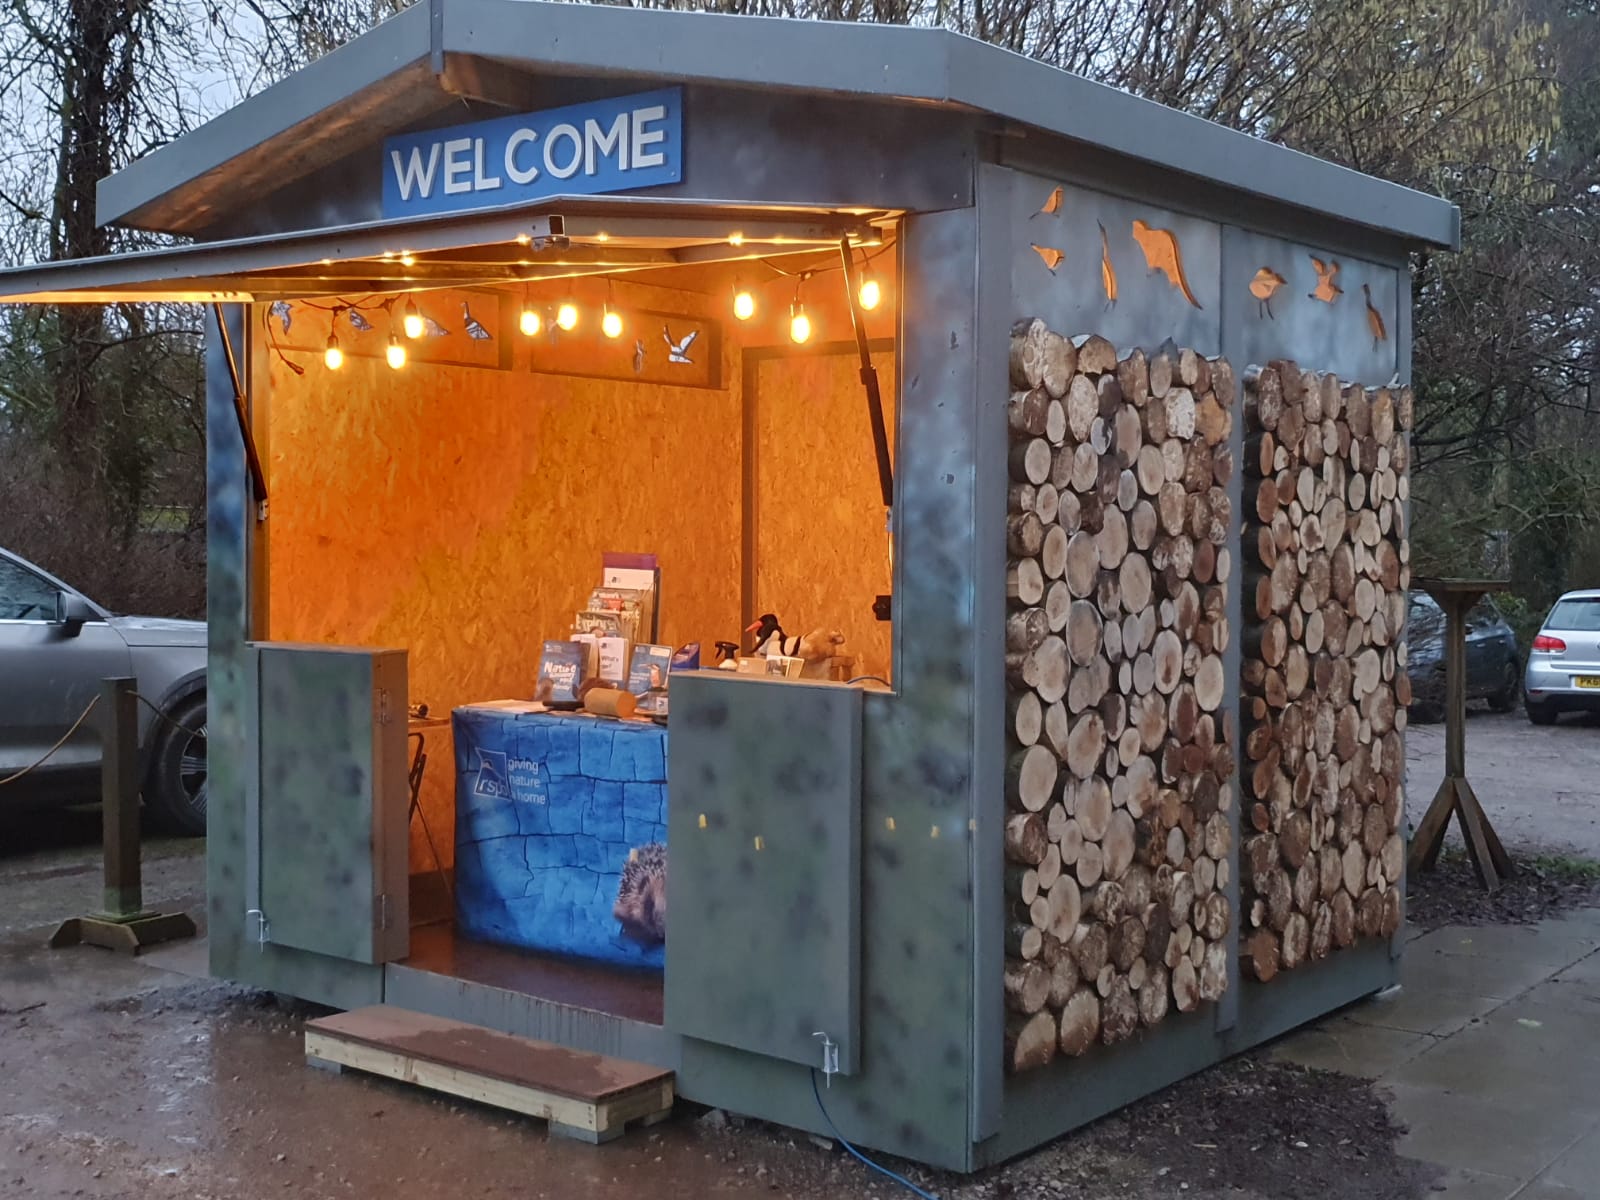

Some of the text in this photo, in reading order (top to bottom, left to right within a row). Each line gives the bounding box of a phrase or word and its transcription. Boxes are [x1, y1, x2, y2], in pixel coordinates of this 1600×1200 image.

[391, 105, 665, 201] WELCOME
[508, 757, 539, 775] giving
[510, 775, 540, 788] nature
[517, 789, 546, 805] home
